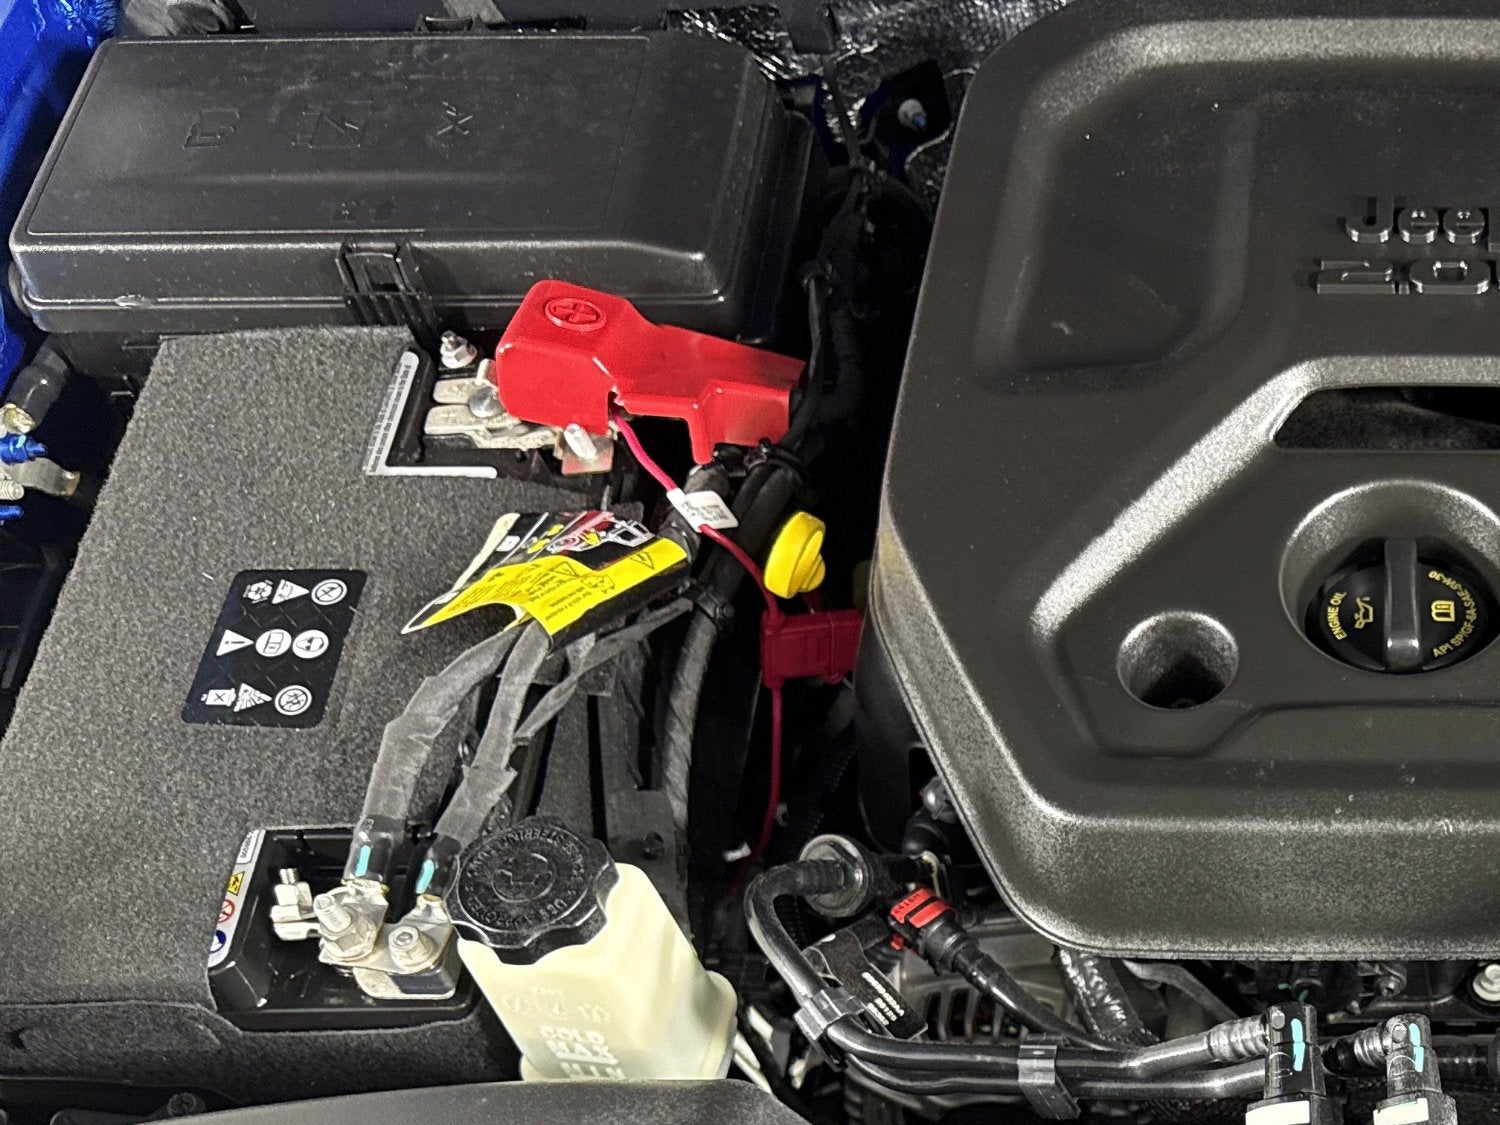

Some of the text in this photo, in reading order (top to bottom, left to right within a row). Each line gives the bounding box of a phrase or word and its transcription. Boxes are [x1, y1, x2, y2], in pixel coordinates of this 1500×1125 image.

[1326, 590, 1348, 640] ENGINE OIL
[1432, 643, 1454, 658] API
[546, 1040, 614, 1060] MAX
